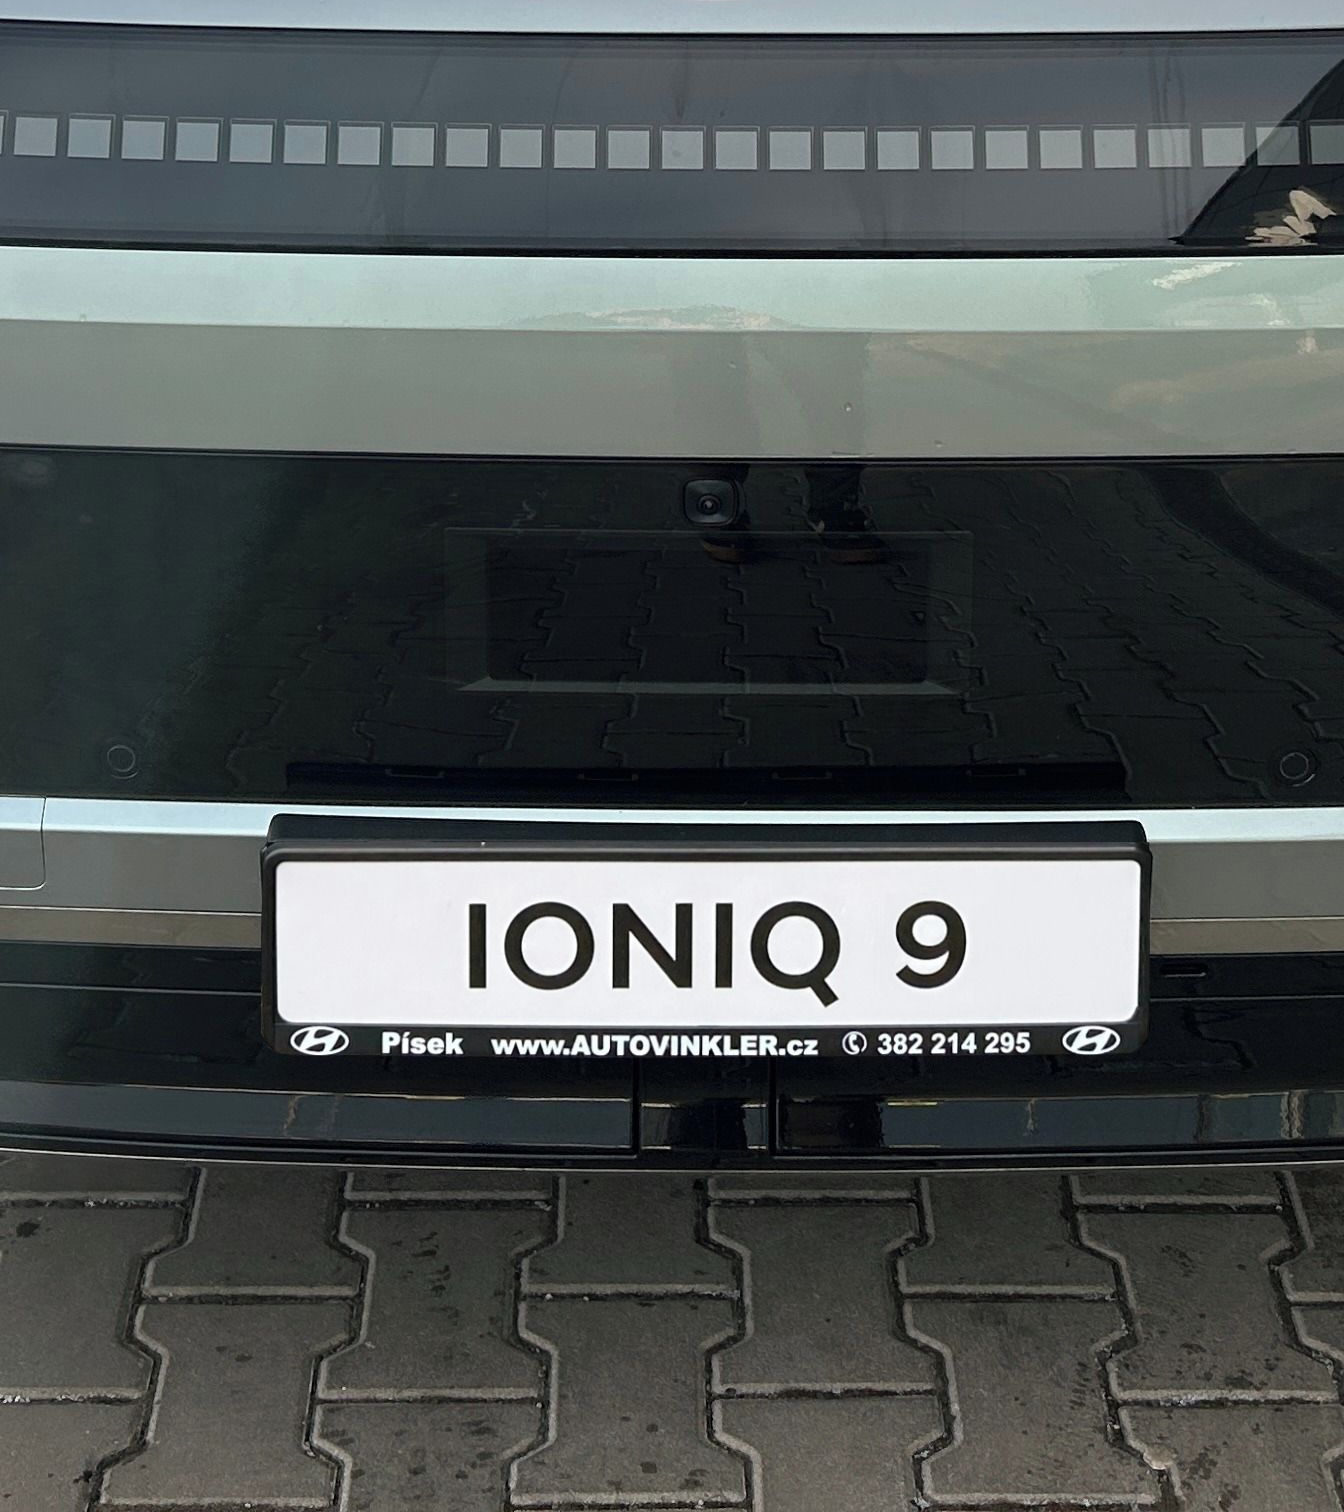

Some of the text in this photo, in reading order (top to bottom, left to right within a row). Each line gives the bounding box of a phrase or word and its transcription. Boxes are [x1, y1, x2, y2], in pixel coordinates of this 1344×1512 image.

[468, 900, 967, 1008] IONIQ 9
[381, 1030, 1031, 1057] Písek www.AUTOVINKLER.cz 382 214 295
